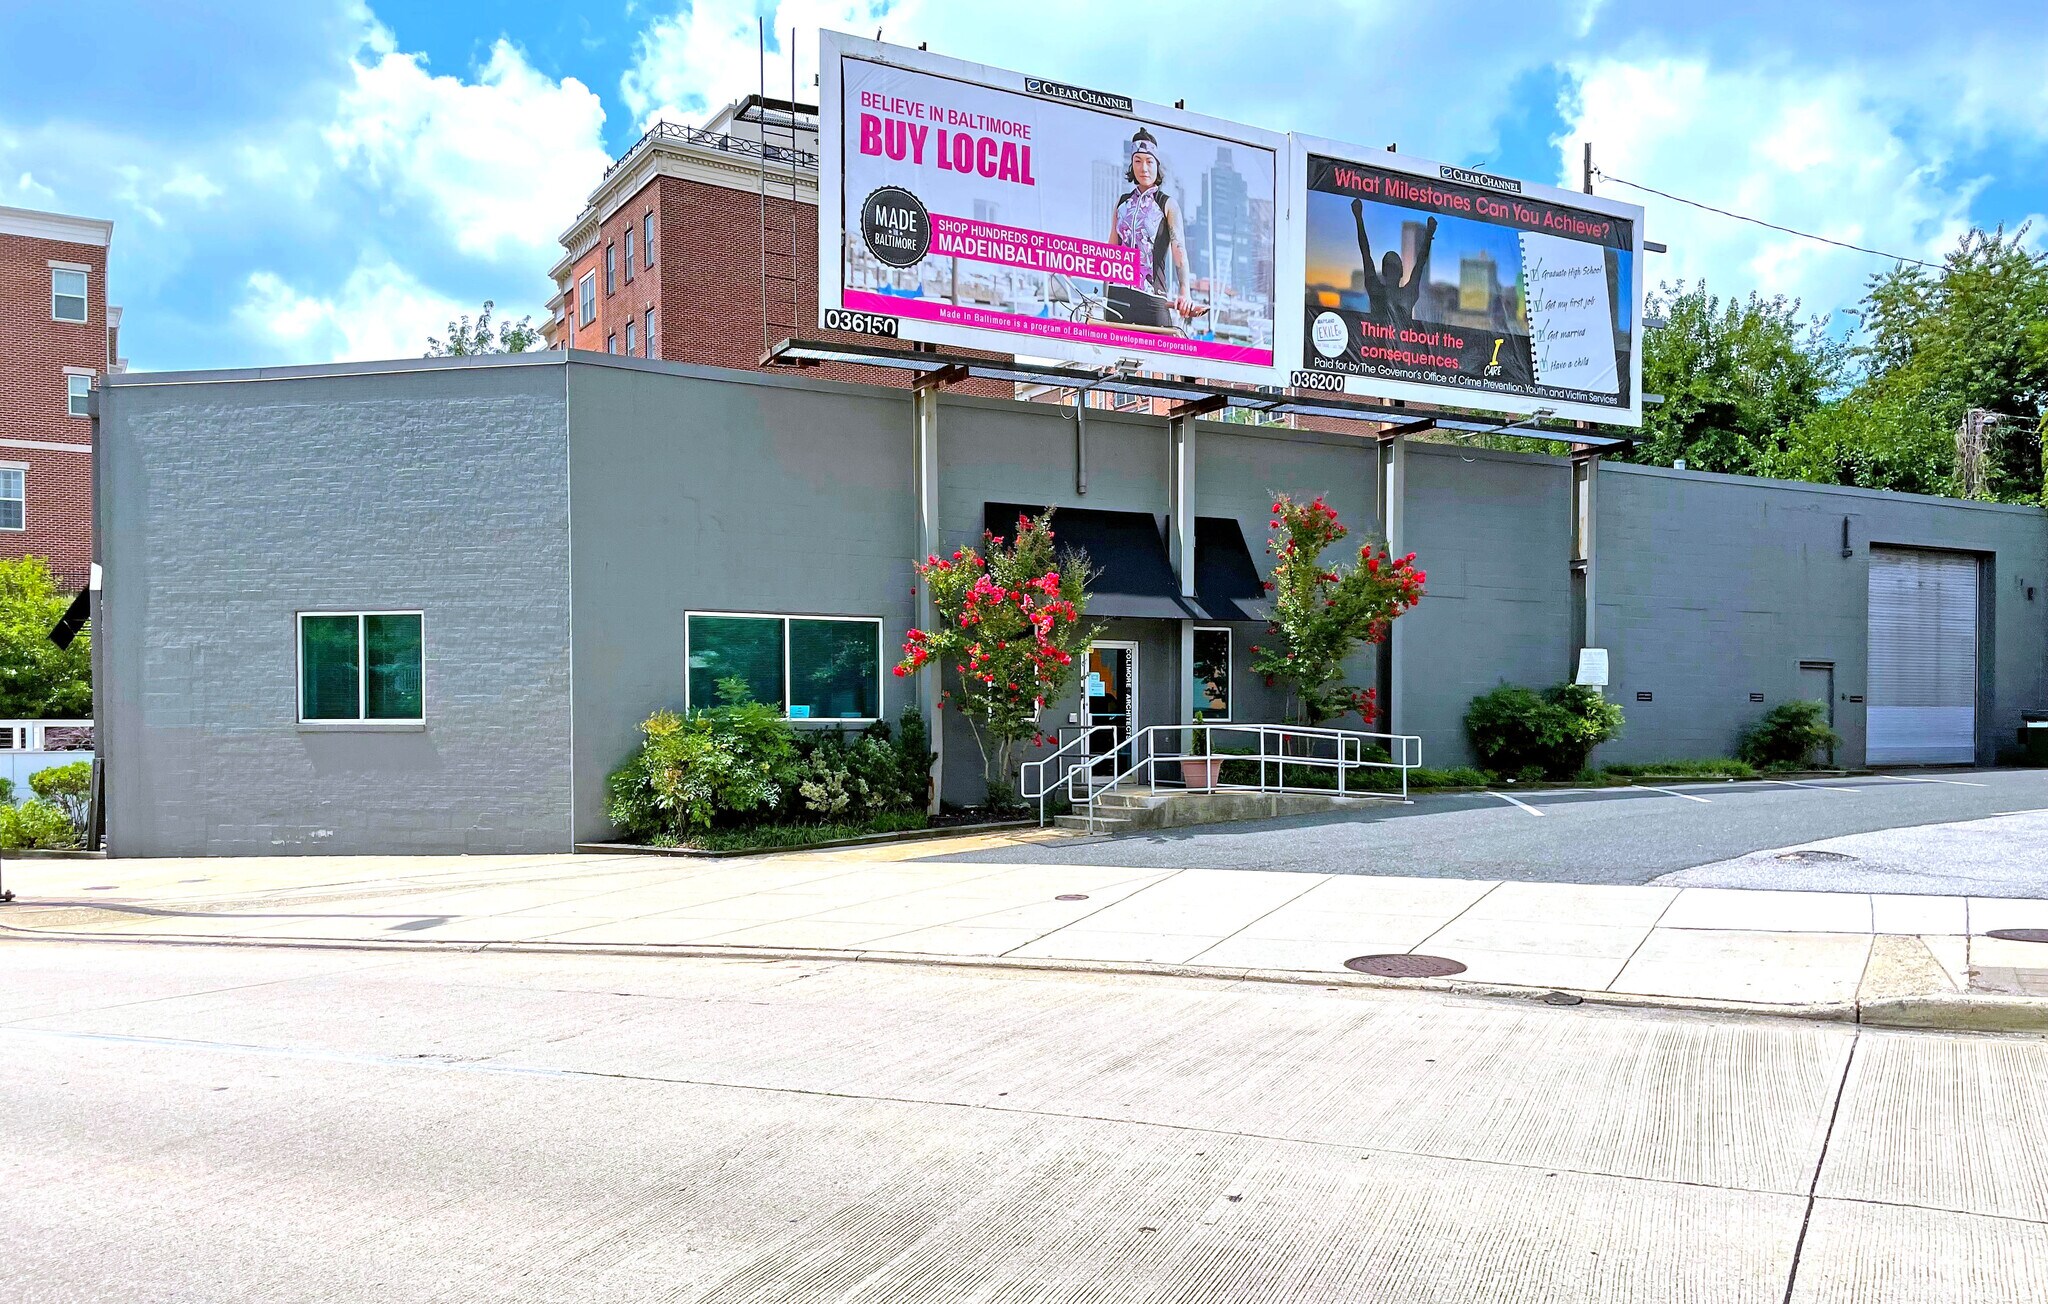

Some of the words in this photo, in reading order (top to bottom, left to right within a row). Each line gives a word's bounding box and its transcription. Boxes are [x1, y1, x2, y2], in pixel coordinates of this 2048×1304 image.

[861, 91, 925, 119] BELIEVE
[929, 105, 944, 123] IN
[948, 109, 1032, 141] BALTIMORE
[860, 112, 929, 165] BUY
[937, 128, 1035, 186] LOCAL
[1334, 167, 1380, 194] What
[1385, 178, 1471, 212] Milestones
[1475, 196, 1509, 219] Can
[1513, 202, 1539, 225] You
[1543, 210, 1610, 239] Achieve?
[875, 204, 917, 232] MADE
[874, 232, 917, 251] BALTIMORE
[938, 219, 968, 234] SHOP
[971, 225, 1028, 244] HUNDREDS
[1030, 235, 1044, 247] OF
[1047, 238, 1080, 254] LOCAL
[1082, 244, 1121, 261] BRANDS
[1123, 252, 1136, 263] AT
[938, 233, 1135, 282] MADEINBALTIMORE.ORG
[1567, 266, 1581, 279] High
[1582, 264, 1603, 276] School
[1545, 299, 1556, 311] Get
[1569, 297, 1583, 307] first
[826, 310, 897, 335] 036150
[939, 308, 961, 320] Made
[963, 312, 972, 320] In
[974, 313, 1011, 326] Baltimore
[1013, 318, 1021, 328] is
[1030, 322, 1061, 333] program
[1063, 326, 1071, 334] of
[1073, 328, 1108, 340] Baltimore
[1110, 332, 1156, 347] Development
[1157, 339, 1198, 352] Corporation
[1318, 324, 1339, 339] EXILE
[1360, 321, 1396, 340] Think
[1400, 328, 1440, 346] about
[1442, 333, 1464, 349] the
[1547, 330, 1559, 341] Get
[1560, 328, 1586, 339] married
[1360, 345, 1462, 370] consequences.
[1489, 338, 1504, 366] I
[1483, 364, 1502, 377] CARE
[1550, 360, 1567, 371] Have
[1291, 371, 1344, 391] 036200
[1314, 357, 1334, 368] Paid
[1335, 359, 1348, 370] for
[1349, 362, 1360, 373] by
[1360, 362, 1376, 374] The
[1377, 365, 1422, 380] Governor's
[1423, 370, 1447, 383] Office
[1448, 374, 1457, 384] of
[1458, 375, 1482, 387] Crime
[1549, 387, 1565, 398] and
[1565, 390, 1588, 401] Victim
[1588, 392, 1618, 405] Services
